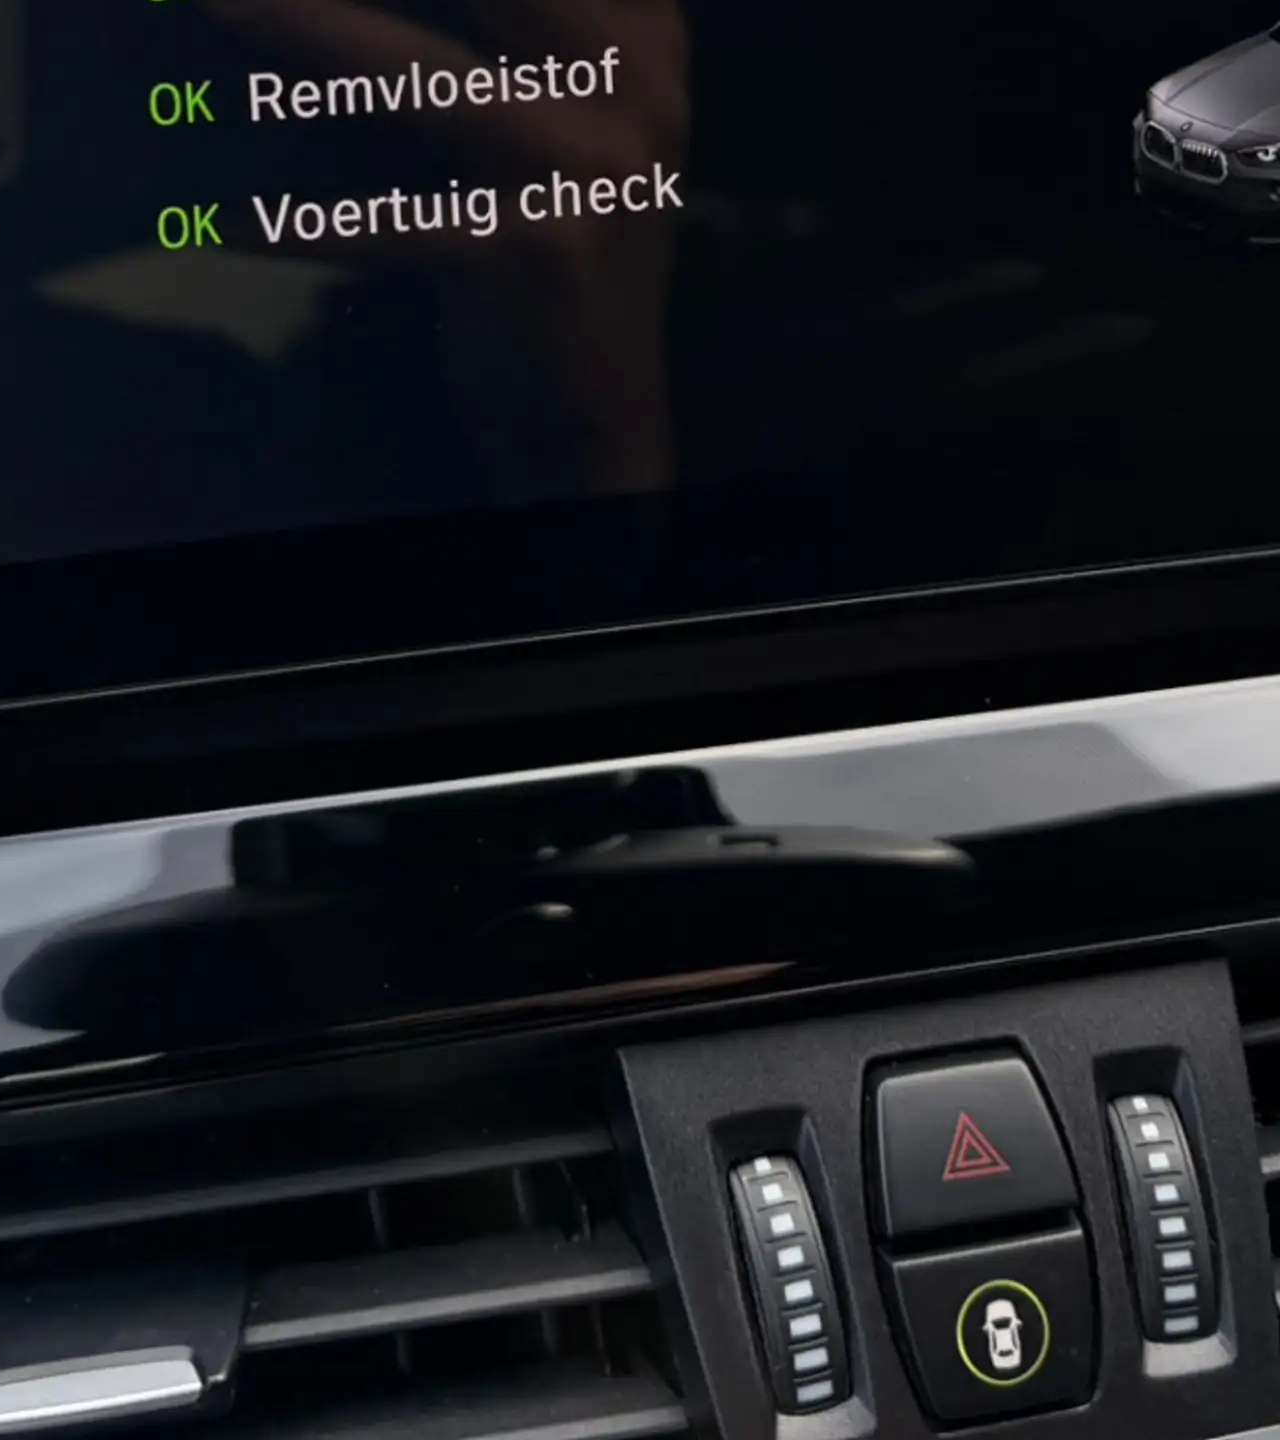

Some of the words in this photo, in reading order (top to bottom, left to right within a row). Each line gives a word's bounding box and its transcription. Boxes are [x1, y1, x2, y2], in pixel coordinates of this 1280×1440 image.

[150, 80, 214, 126] OK
[249, 46, 620, 122] Remvloeistof
[158, 203, 222, 249] OK
[252, 179, 498, 243] Voertuig
[519, 162, 683, 221] check
